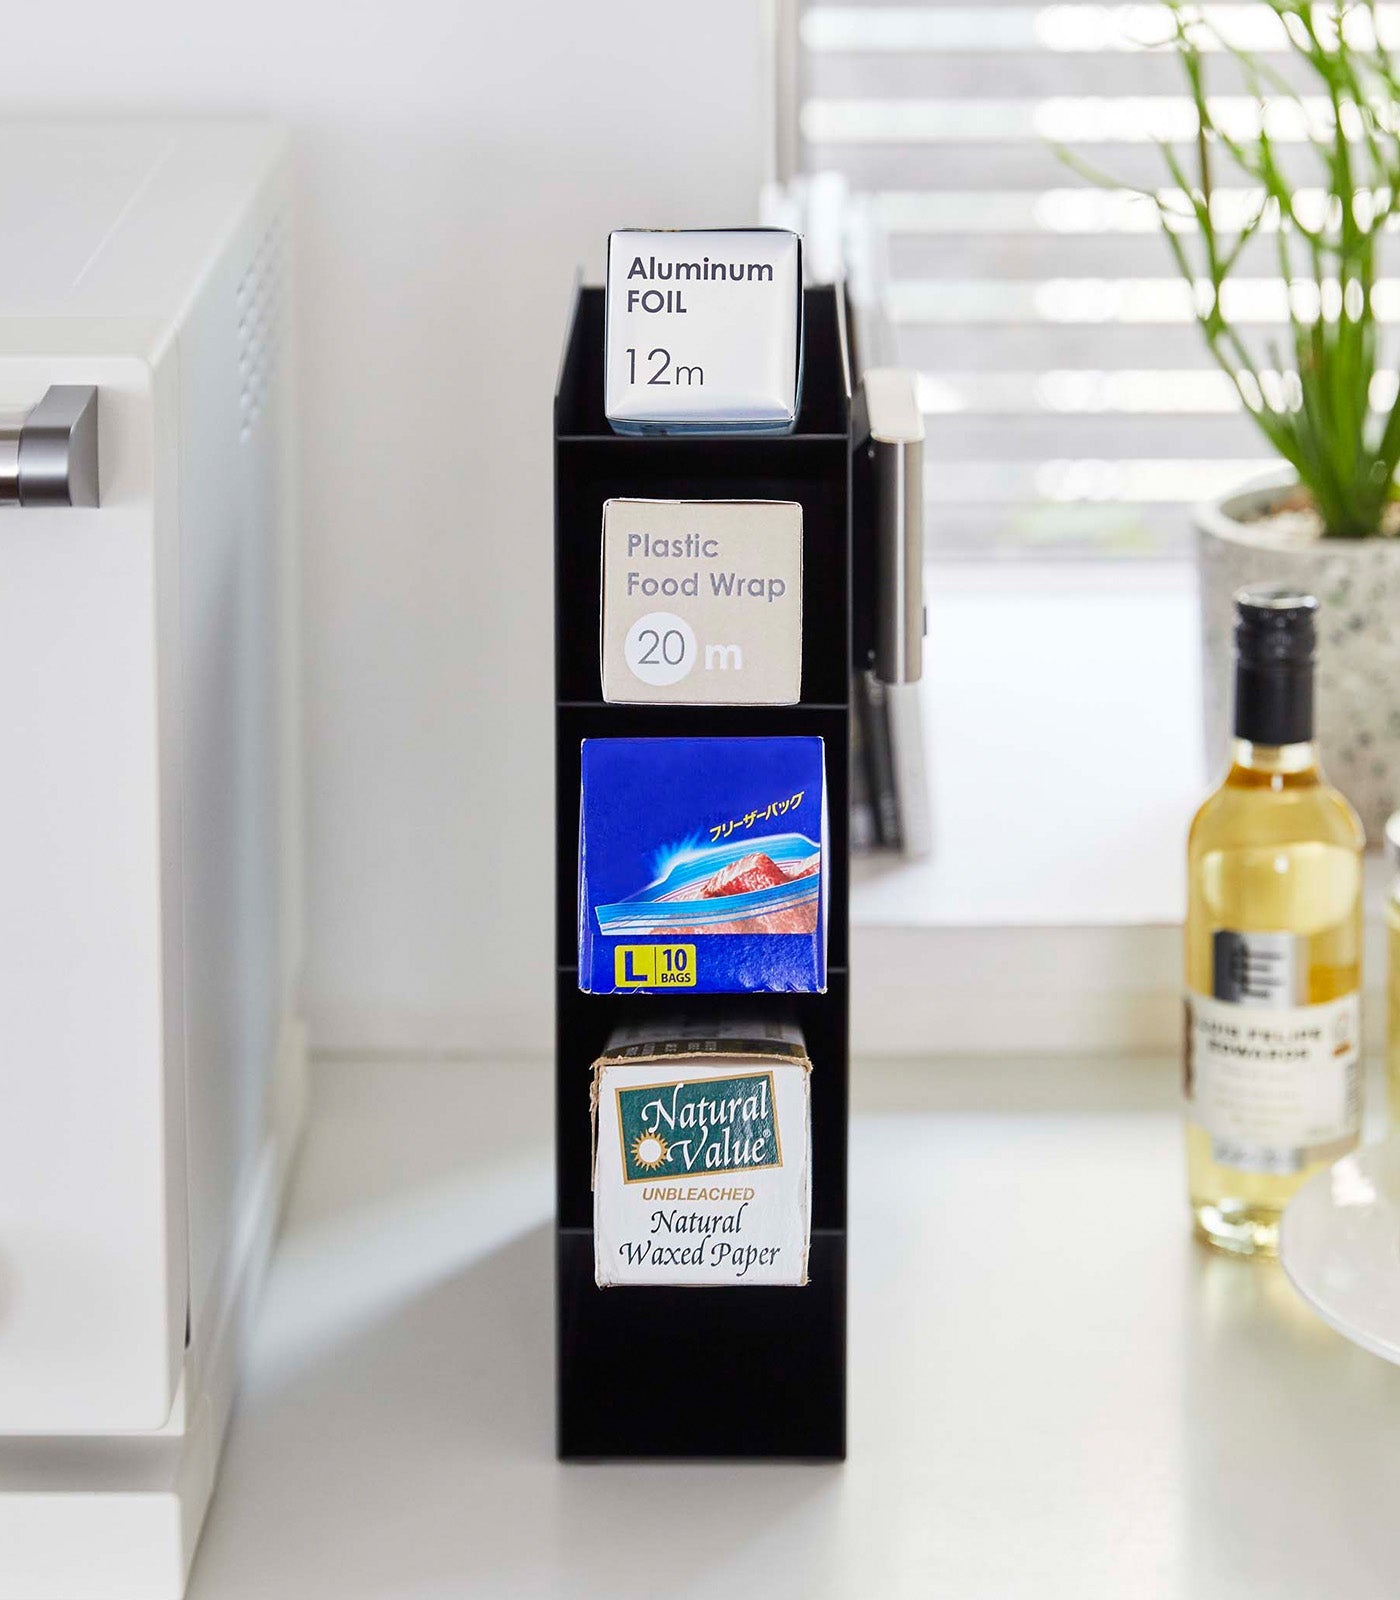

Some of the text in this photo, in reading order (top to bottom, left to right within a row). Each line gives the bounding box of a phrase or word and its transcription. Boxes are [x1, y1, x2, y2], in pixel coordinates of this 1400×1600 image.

[627, 256, 774, 282] Aluminum
[627, 289, 687, 314] FOIL
[625, 347, 704, 386] 12m
[627, 533, 719, 558] Plastic
[627, 572, 786, 603] Food Wrap
[637, 629, 743, 671] 20 m
[709, 791, 805, 843] フリーザーバッグ
[624, 950, 648, 982] L
[662, 948, 688, 972] 10
[660, 972, 691, 984] BAGS
[641, 1079, 769, 1133] Natural
[642, 1187, 755, 1201] UNBLEACHED
[650, 1202, 749, 1234] Natural
[619, 1234, 781, 1277] Waxed Paper
